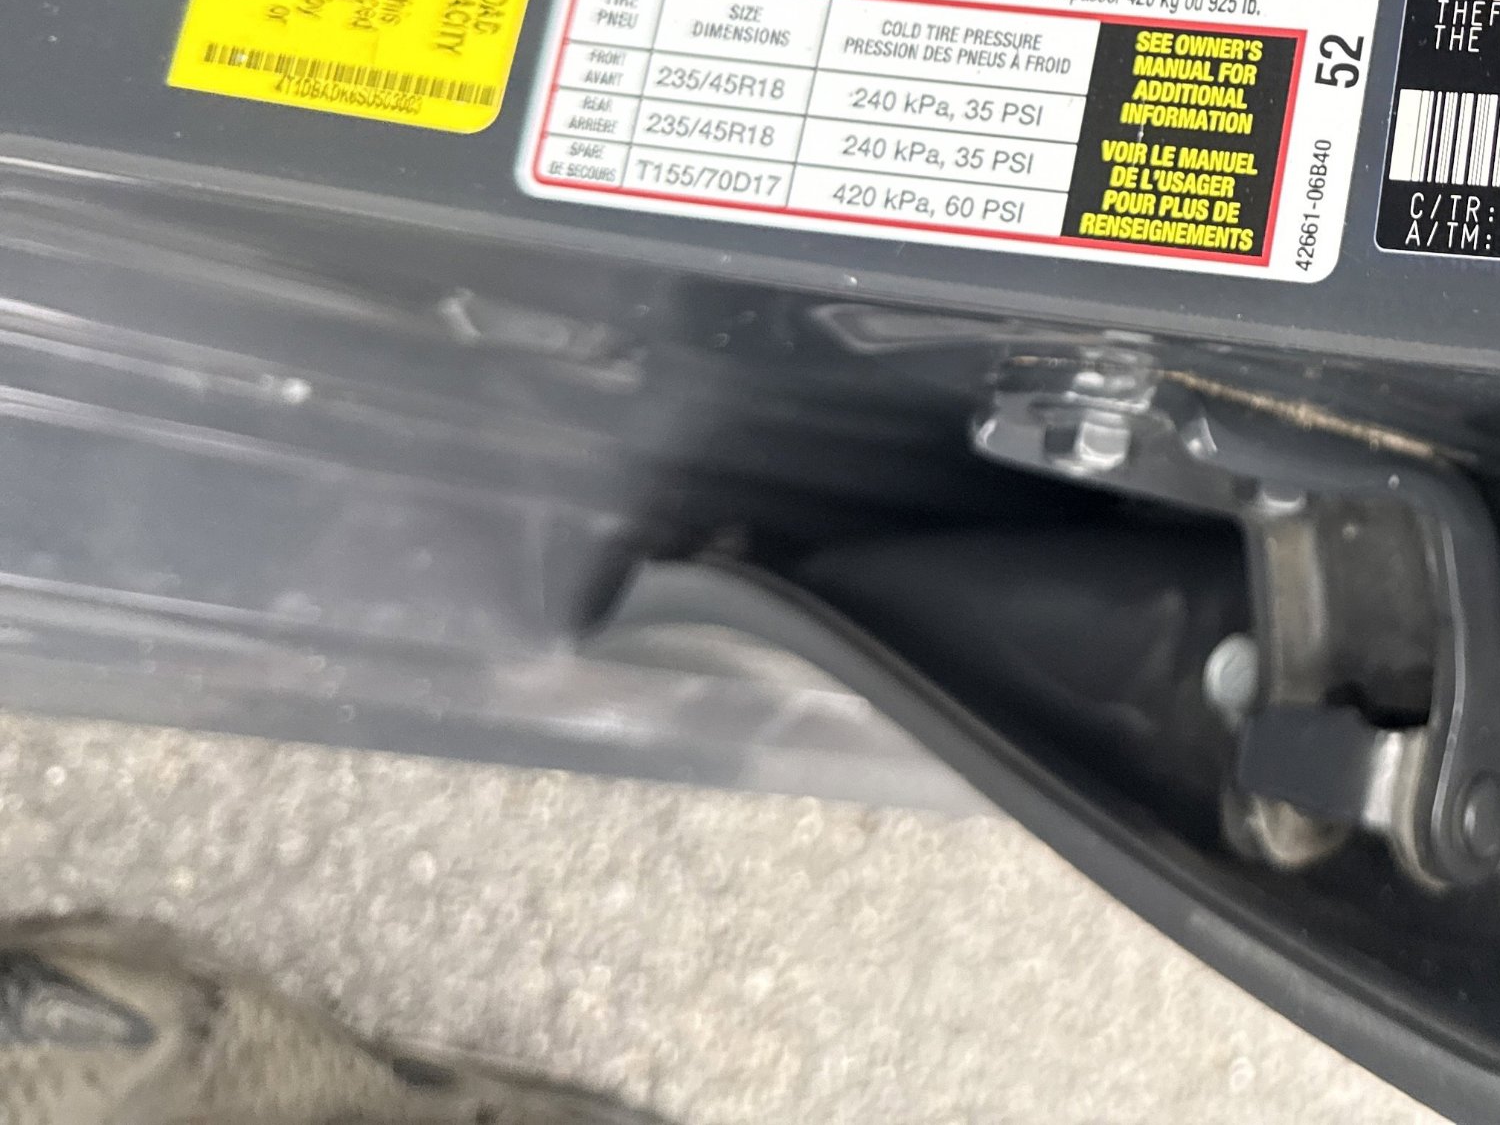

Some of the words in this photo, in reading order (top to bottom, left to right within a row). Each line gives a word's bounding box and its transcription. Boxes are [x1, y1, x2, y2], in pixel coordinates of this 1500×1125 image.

[595, 9, 639, 28] PNEU
[727, 4, 764, 23] SIZE
[691, 20, 790, 46] DIMENSIONS
[880, 19, 922, 39] COLD
[926, 23, 960, 43] TIRE
[962, 27, 1042, 51] PRESSURE
[1135, 30, 1174, 54] SEE
[1174, 33, 1263, 61] OWNER'S
[1434, 24, 1483, 53] THE
[843, 37, 919, 59] PRESSION
[922, 44, 953, 63] DES
[956, 47, 1007, 68] PNEUS
[1024, 54, 1071, 75] FROID
[1132, 54, 1214, 82] MANUAL
[1217, 61, 1258, 86] FOR
[1314, 34, 1364, 88] 52
[655, 65, 785, 100] 235/45R18
[1132, 79, 1247, 109] ADDITIONAL
[851, 87, 897, 112] 240
[903, 92, 955, 121] kPa,
[963, 98, 994, 122] 35
[1001, 101, 1043, 126] PSI
[1120, 102, 1253, 134] INFORMATION
[645, 112, 775, 147] 235/45R18
[841, 134, 887, 159] 240
[893, 139, 945, 169] kPa,
[954, 146, 985, 170] 35
[991, 149, 1034, 174] PSI
[1101, 139, 1148, 165] VOIR
[1149, 143, 1177, 168] LE
[1177, 146, 1258, 175] MANUEL
[637, 158, 781, 196] T155/70D17
[1109, 164, 1139, 189] DE
[1139, 168, 1235, 198] L'USAGER
[831, 183, 877, 207] 420
[883, 187, 935, 218] kPa,
[944, 194, 975, 218] 60
[981, 198, 1025, 224] PSI
[1101, 189, 1157, 216] POUR
[1158, 194, 1210, 221] PLUS
[1211, 200, 1241, 224] DE
[1295, 139, 1332, 271] 42661-06B40
[1079, 212, 1253, 251] RENSEIGNEMENTS
[1404, 219, 1491, 250] A/TM:
